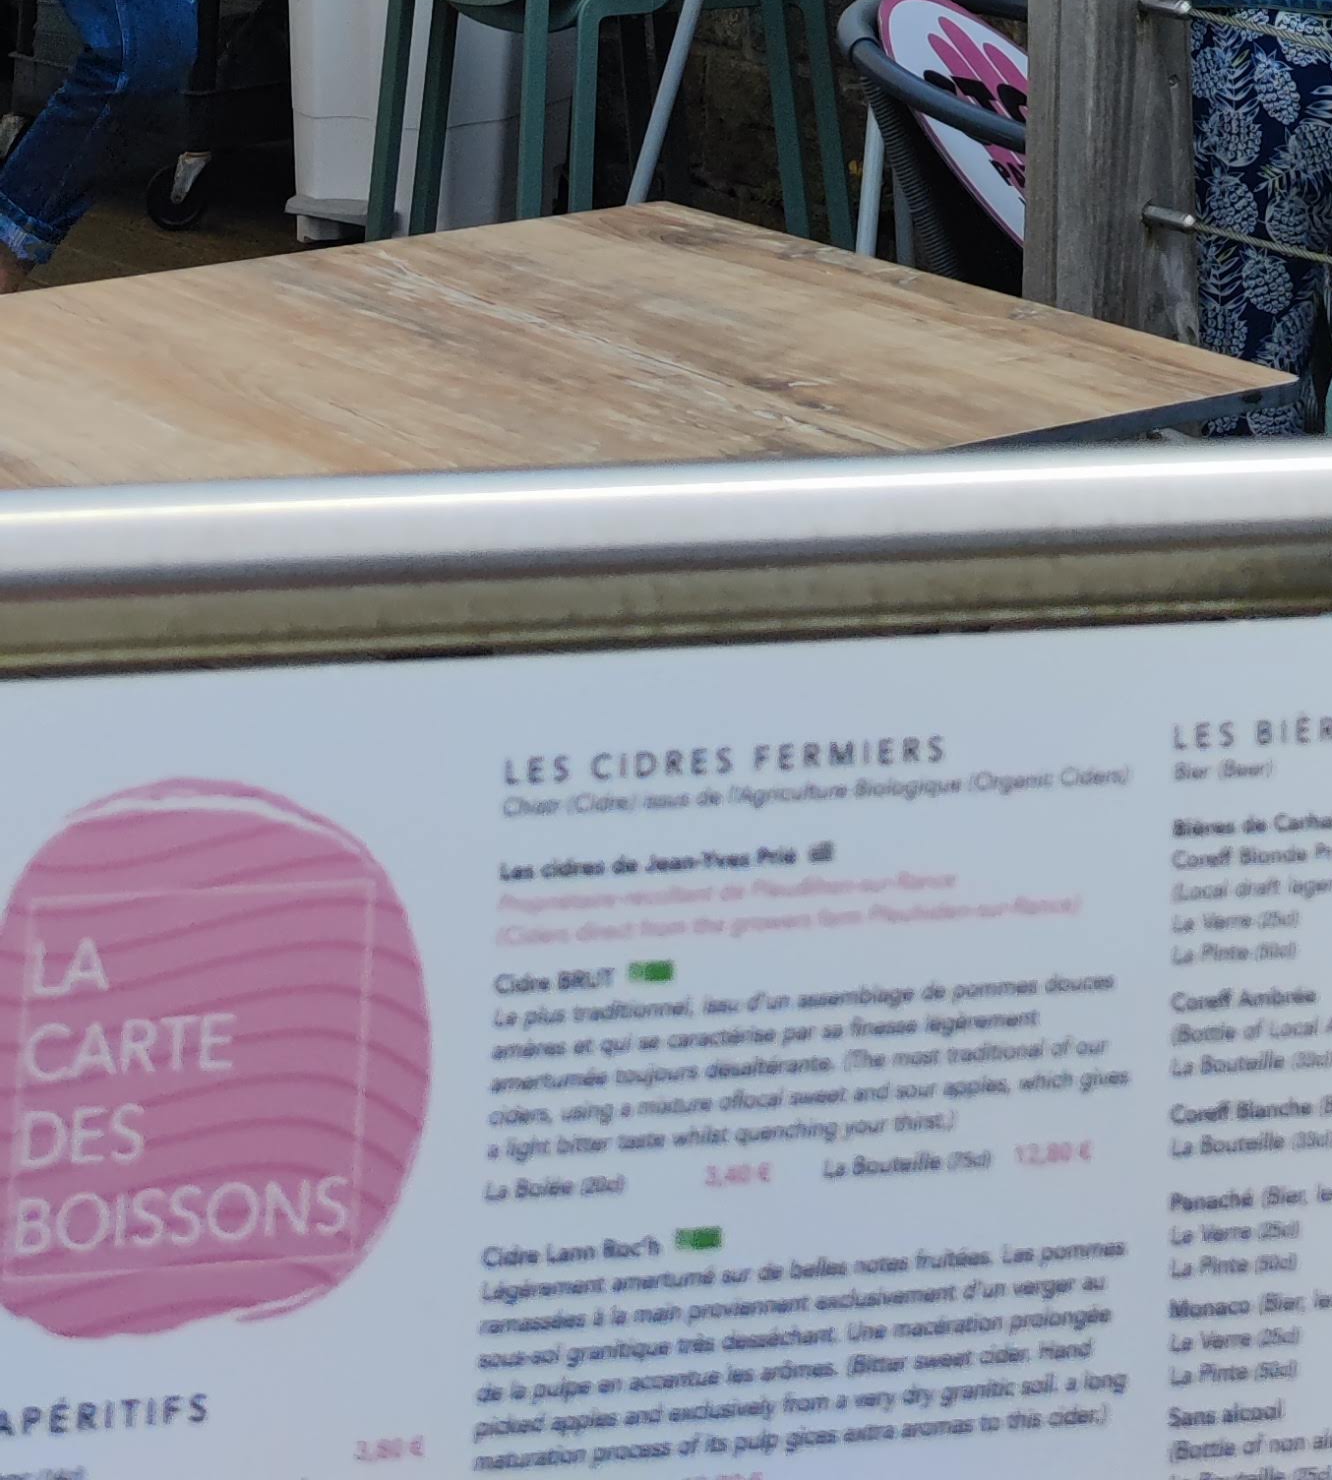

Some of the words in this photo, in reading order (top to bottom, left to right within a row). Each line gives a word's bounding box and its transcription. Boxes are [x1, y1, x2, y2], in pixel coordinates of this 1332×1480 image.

[503, 755, 570, 785] LES
[590, 747, 733, 781] CIDRES
[754, 735, 944, 772] FERMIERS
[1171, 722, 1235, 751] LES
[33, 936, 109, 996] LA
[25, 1012, 237, 1082] CARTE
[22, 1102, 145, 1169] DES
[16, 1175, 349, 1254] BOISSONS
[0, 1393, 209, 1437] APÉRITIFS
